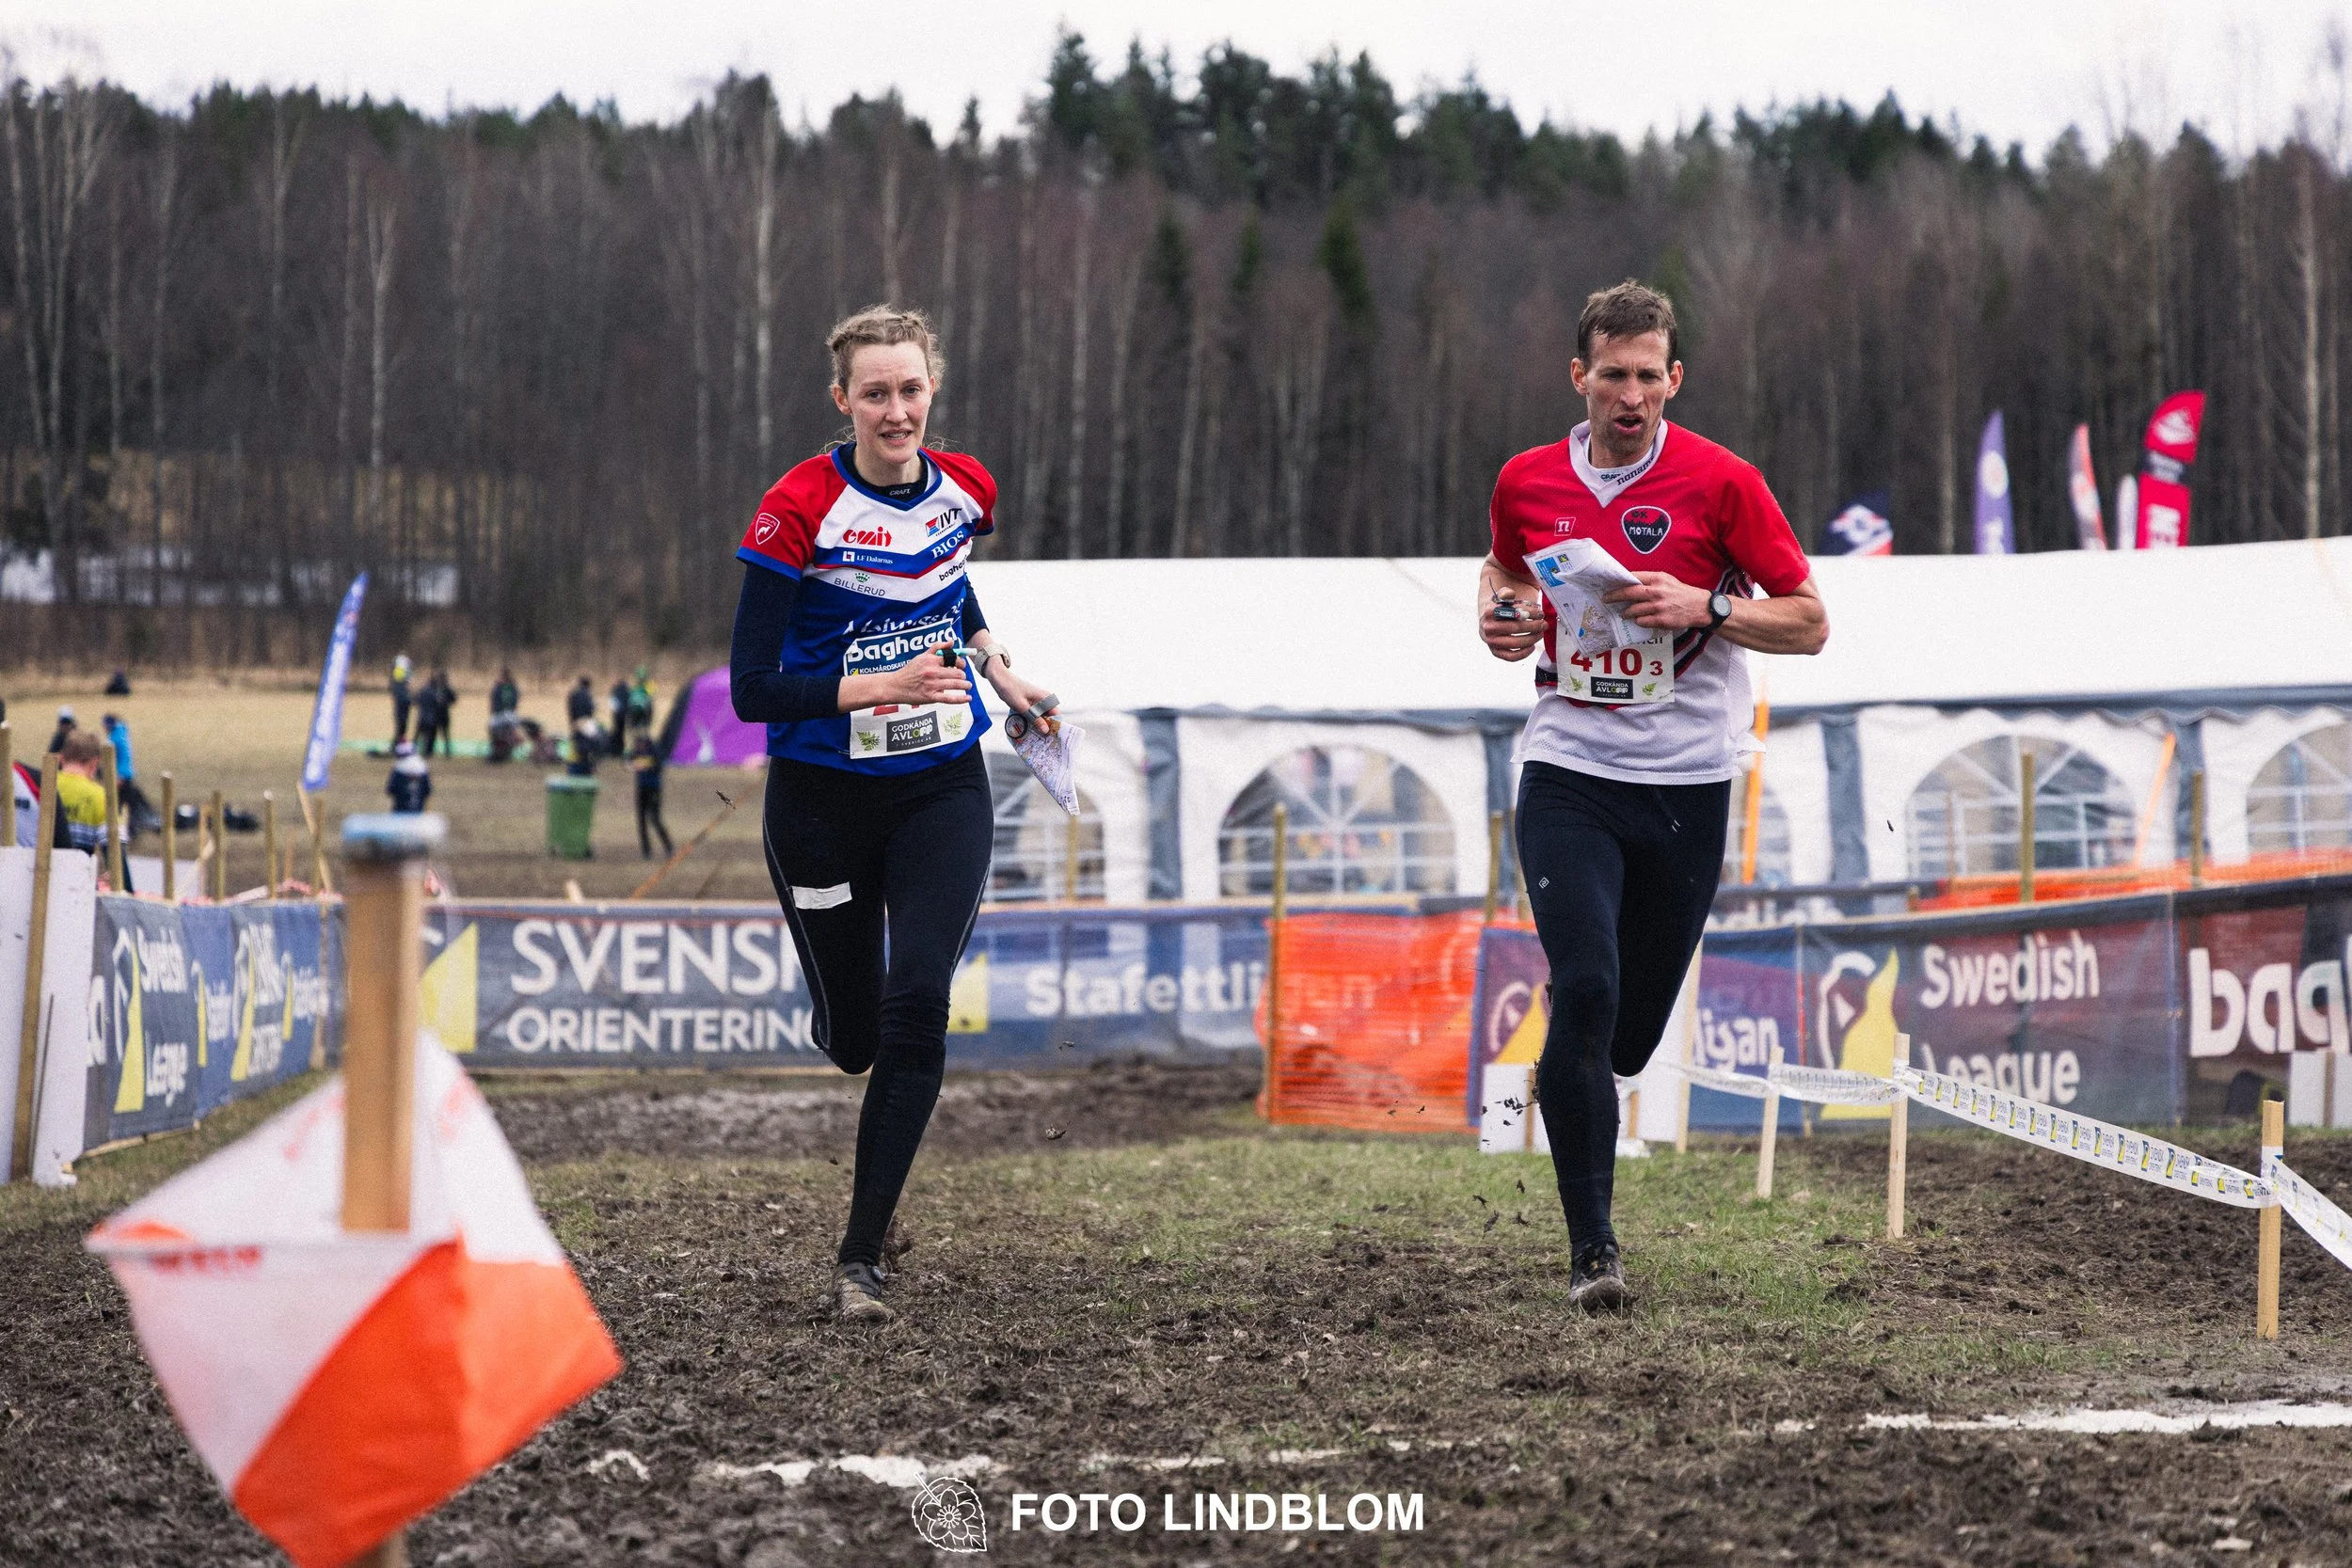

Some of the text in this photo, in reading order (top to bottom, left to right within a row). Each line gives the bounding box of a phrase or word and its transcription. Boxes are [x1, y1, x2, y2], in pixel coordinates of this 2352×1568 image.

[940, 508, 962, 529] IVT
[1629, 527, 1663, 536] MOTALA
[931, 530, 965, 559] BIOS
[834, 578, 885, 596] BILLERUD
[1571, 648, 1663, 675] 410 3
[891, 717, 933, 732] GODKÄNDA
[891, 724, 933, 742] AVLOPP
[1920, 929, 2101, 1009] Swedish
